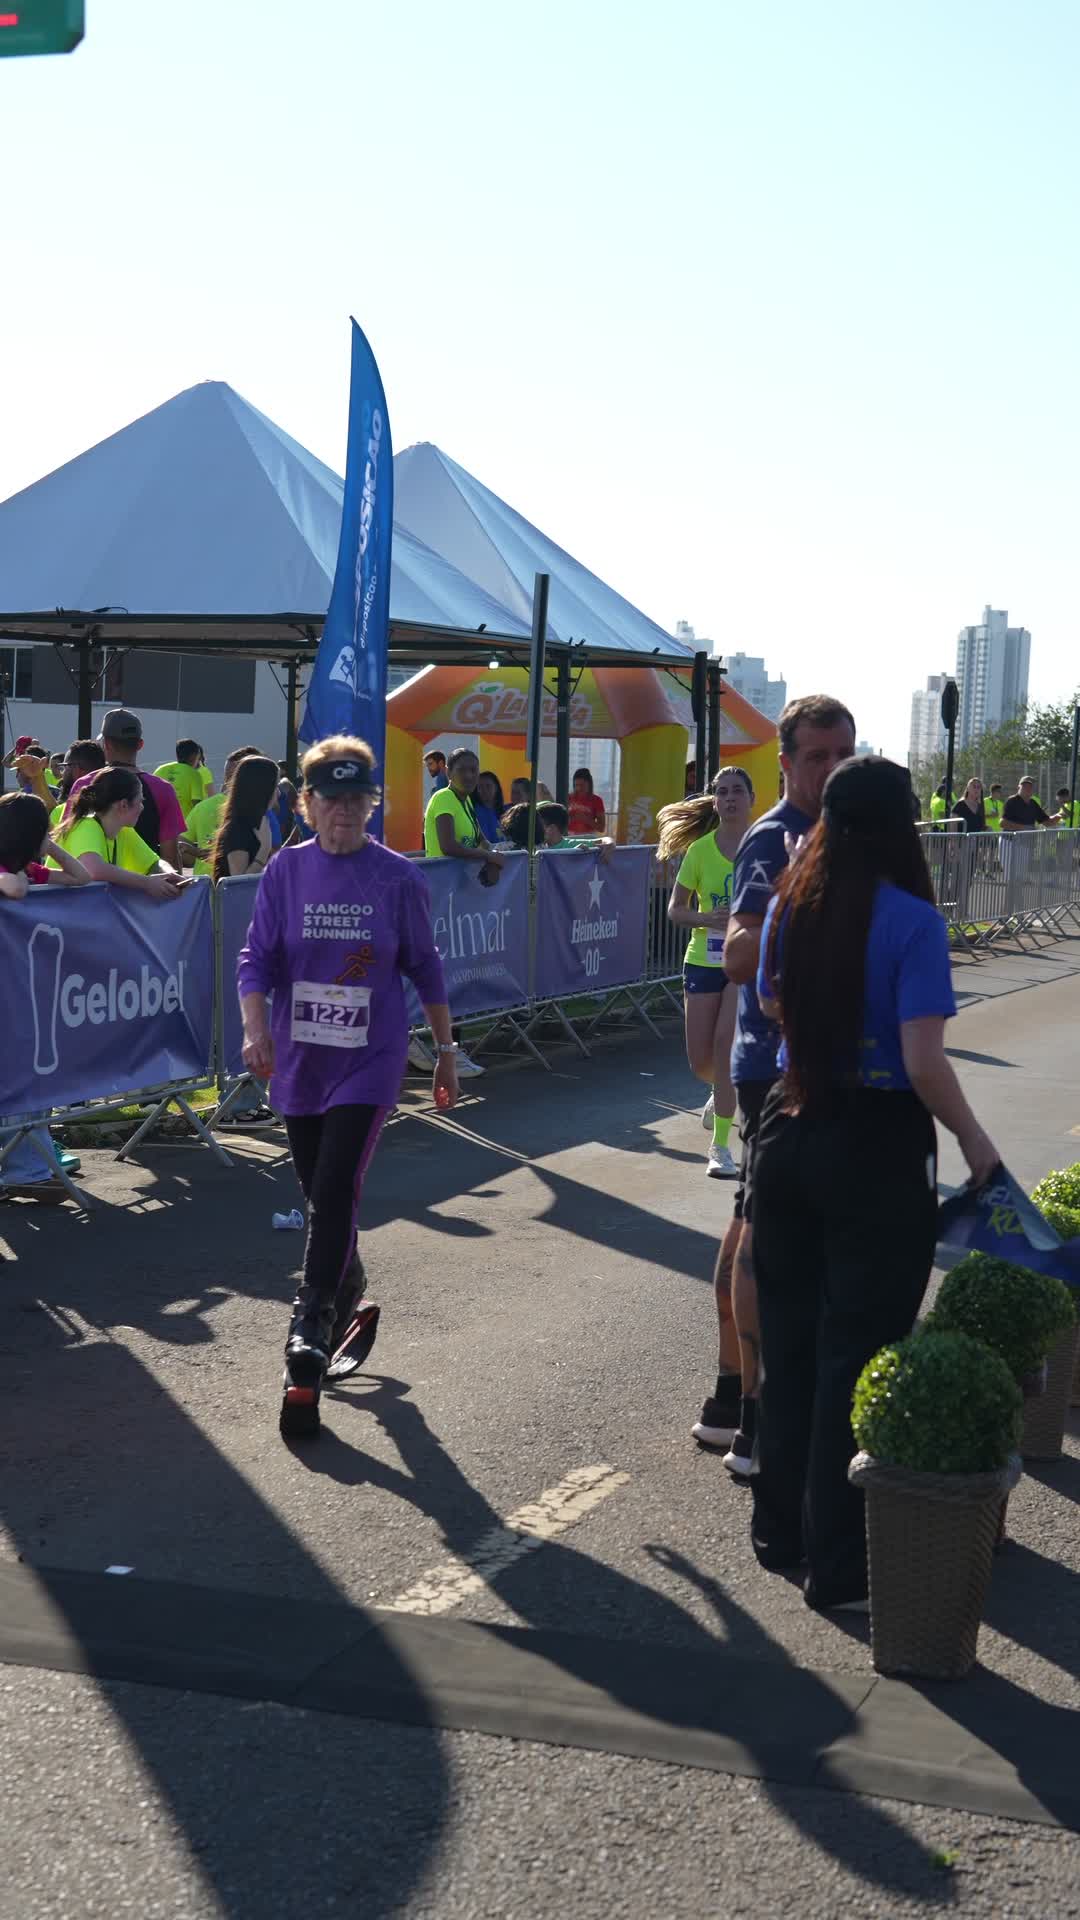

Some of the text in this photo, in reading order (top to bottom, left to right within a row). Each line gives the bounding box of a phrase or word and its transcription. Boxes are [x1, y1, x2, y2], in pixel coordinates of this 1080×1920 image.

[303, 903, 374, 916] KANGOO
[303, 915, 362, 928] STREET
[570, 915, 618, 944] Heineken
[302, 927, 372, 941] RUNNING
[60, 960, 184, 1028] Gelobel
[310, 1003, 360, 1027] 1227
